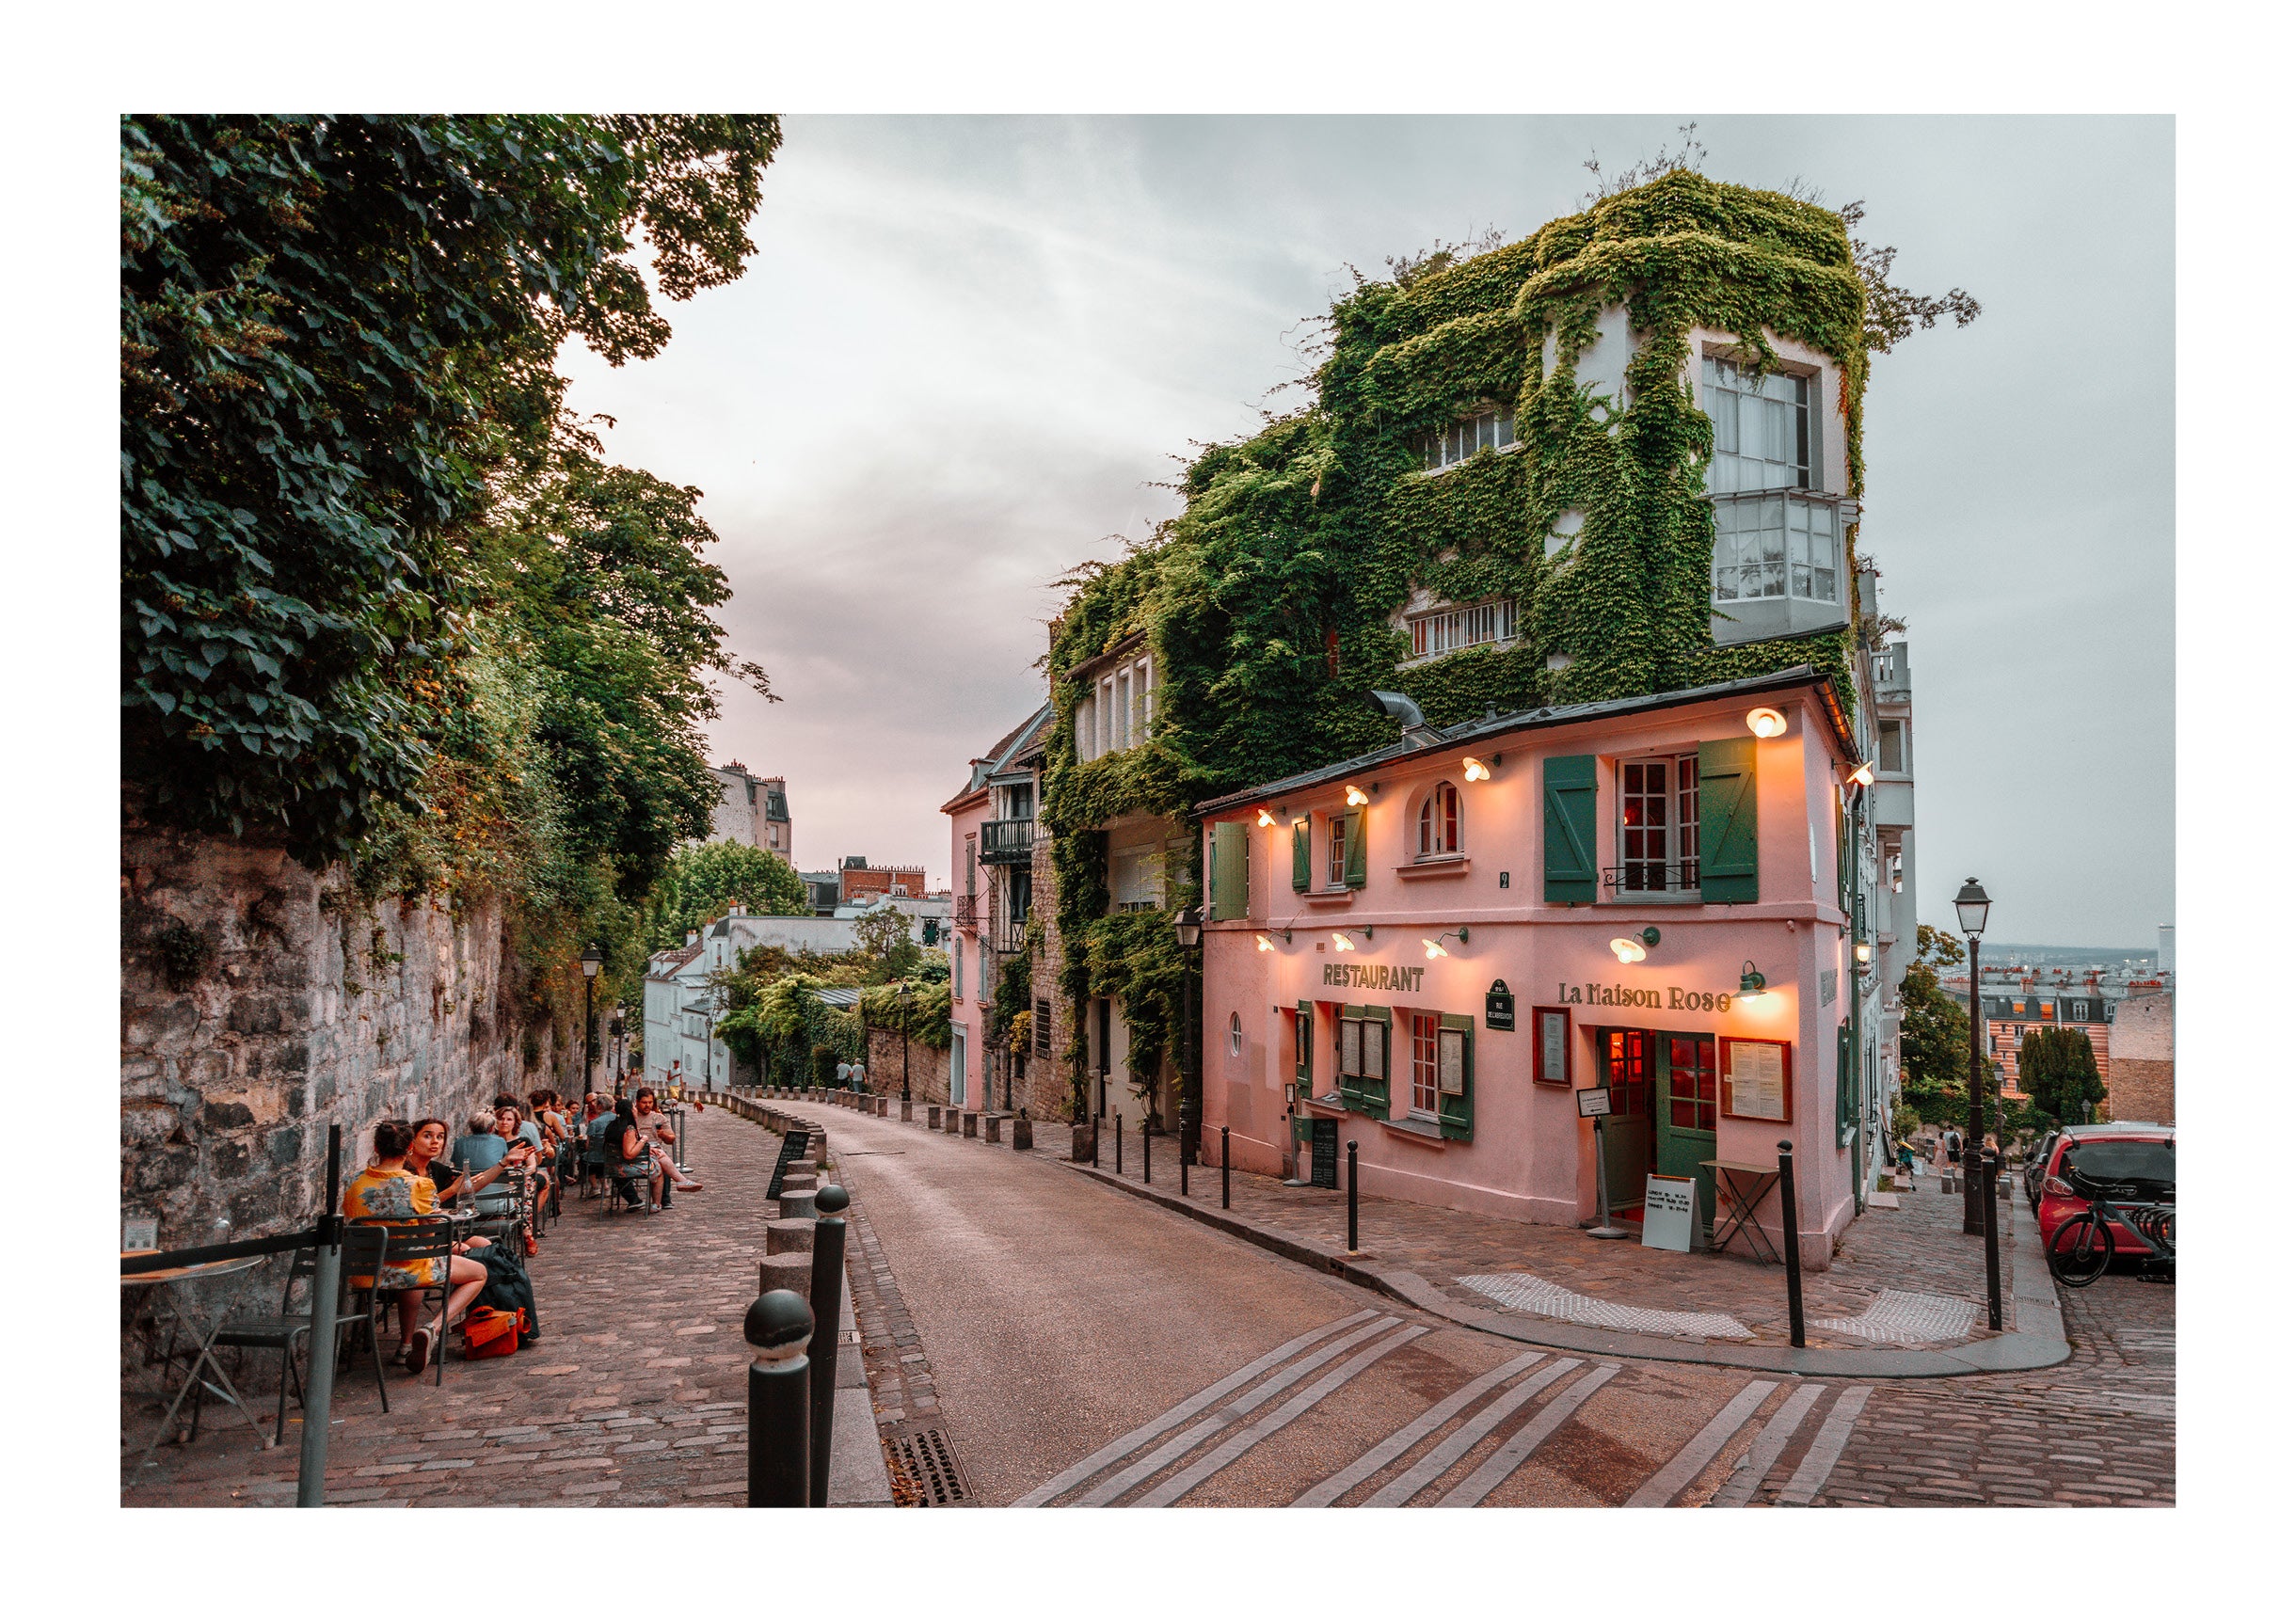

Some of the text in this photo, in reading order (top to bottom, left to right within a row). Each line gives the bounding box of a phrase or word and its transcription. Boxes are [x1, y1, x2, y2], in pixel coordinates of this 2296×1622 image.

[1501, 873, 1507, 887] 2
[1323, 963, 1425, 992] RESTAURANT
[1558, 982, 1731, 1013] La Maison Rose
